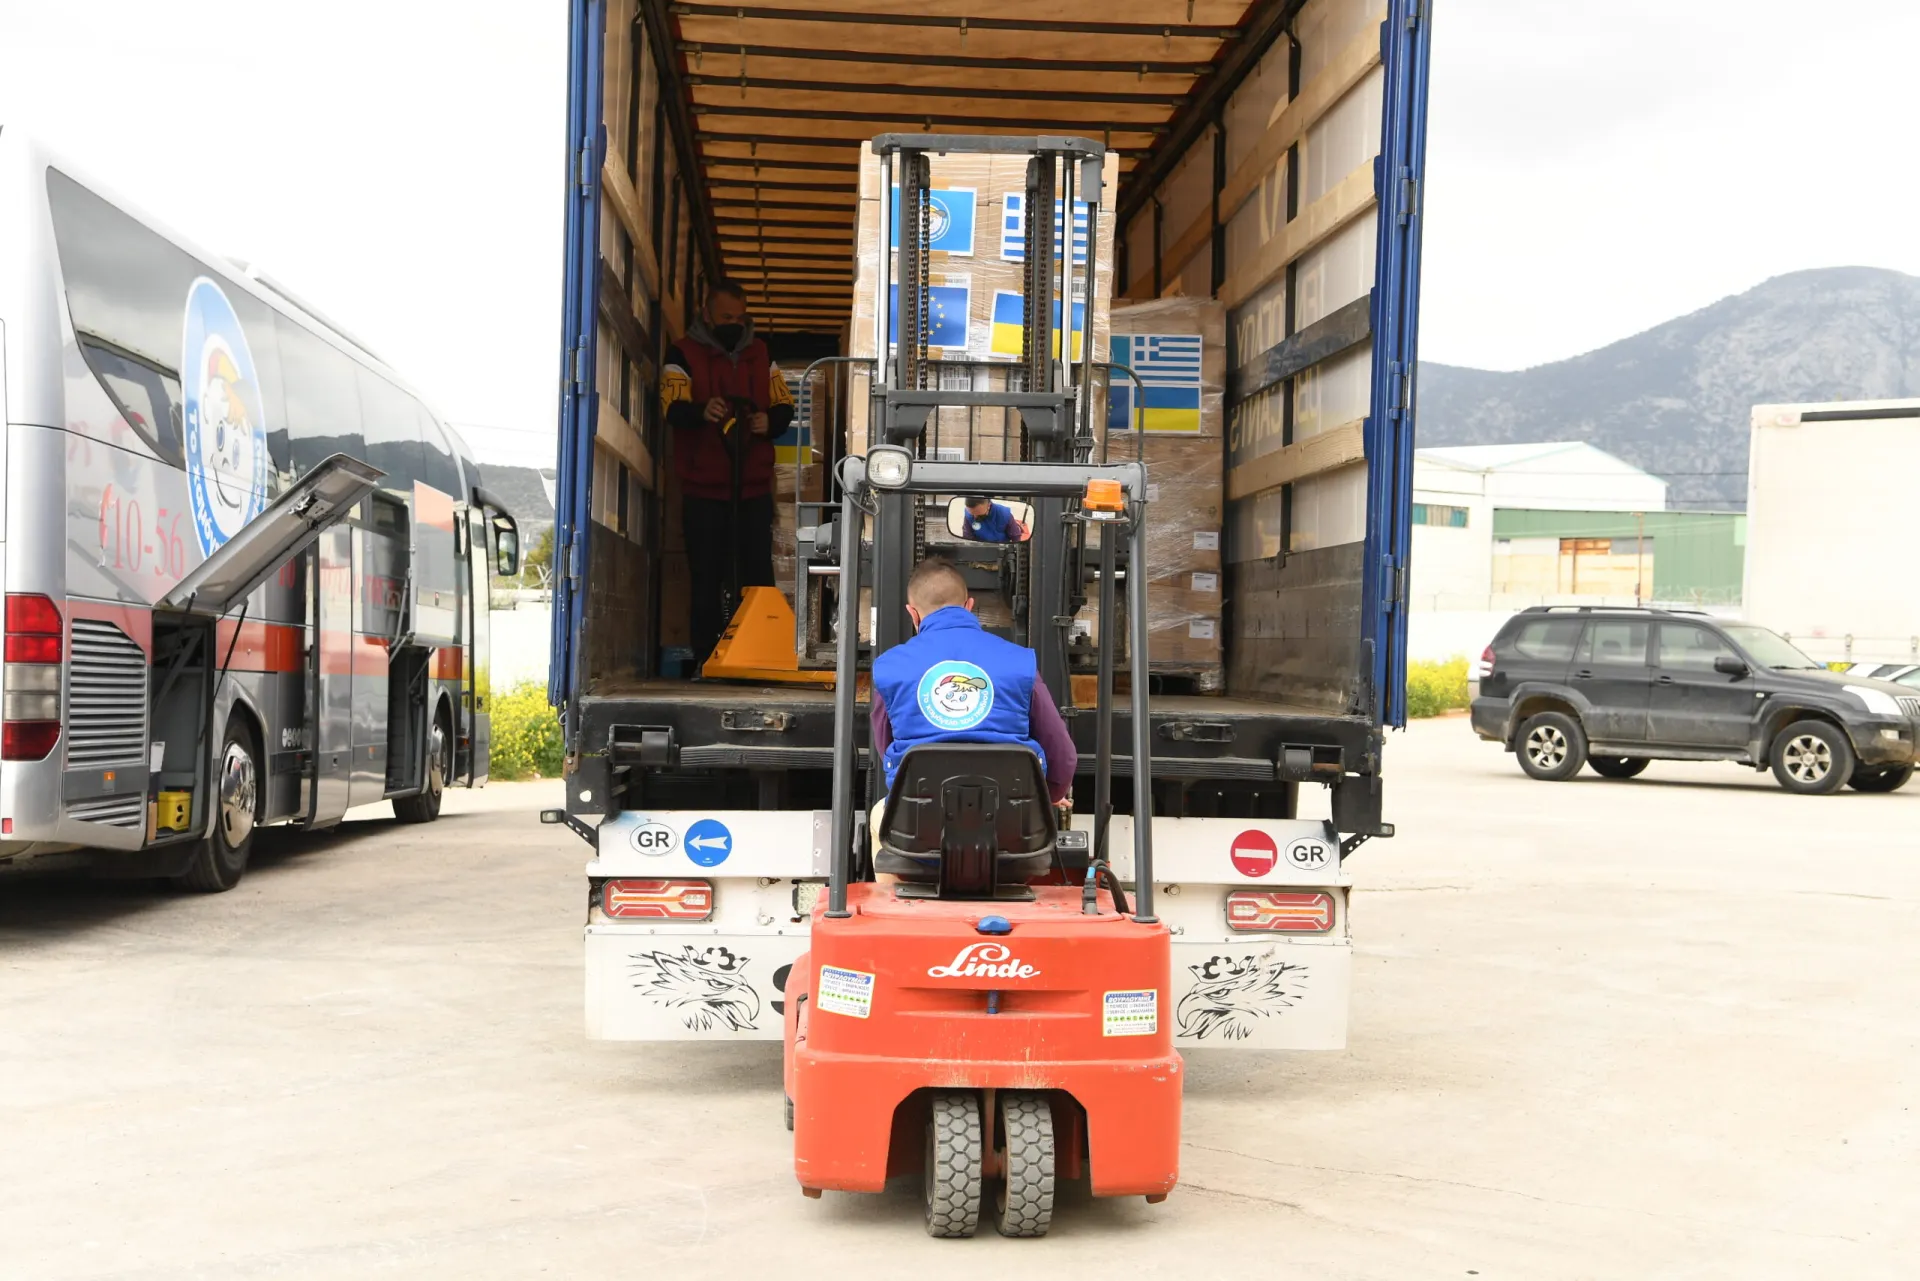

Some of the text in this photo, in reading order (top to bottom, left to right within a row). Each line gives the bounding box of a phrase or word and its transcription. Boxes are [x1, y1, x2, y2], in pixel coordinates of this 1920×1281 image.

[637, 831, 670, 848] GR
[1293, 845, 1325, 862] GR
[927, 942, 1041, 979] Linde
